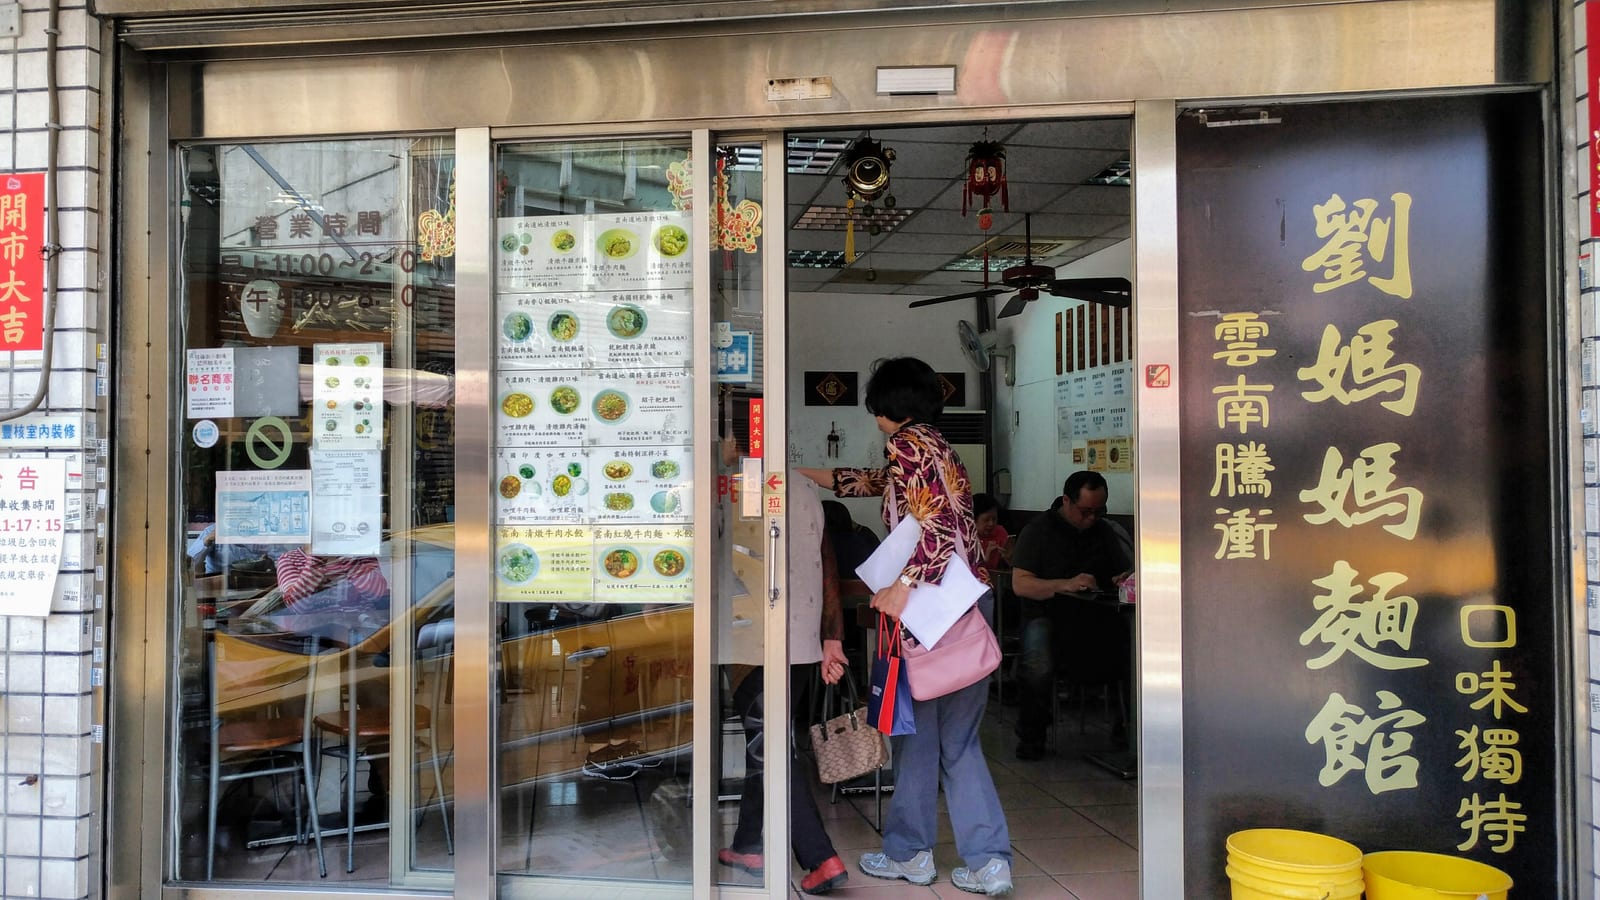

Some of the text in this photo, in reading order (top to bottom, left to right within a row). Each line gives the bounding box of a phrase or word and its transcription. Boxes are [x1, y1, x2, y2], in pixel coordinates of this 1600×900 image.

[0, 193, 31, 344] 開市大吉
[255, 210, 382, 241] 營業時間
[753, 404, 761, 449] 開市大吉
[768, 496, 781, 508] 拉
[1210, 312, 1278, 560] 雲南騰衝
[1298, 192, 1429, 794] 劉媽媽麵館
[1454, 605, 1528, 853] 口味獨特
